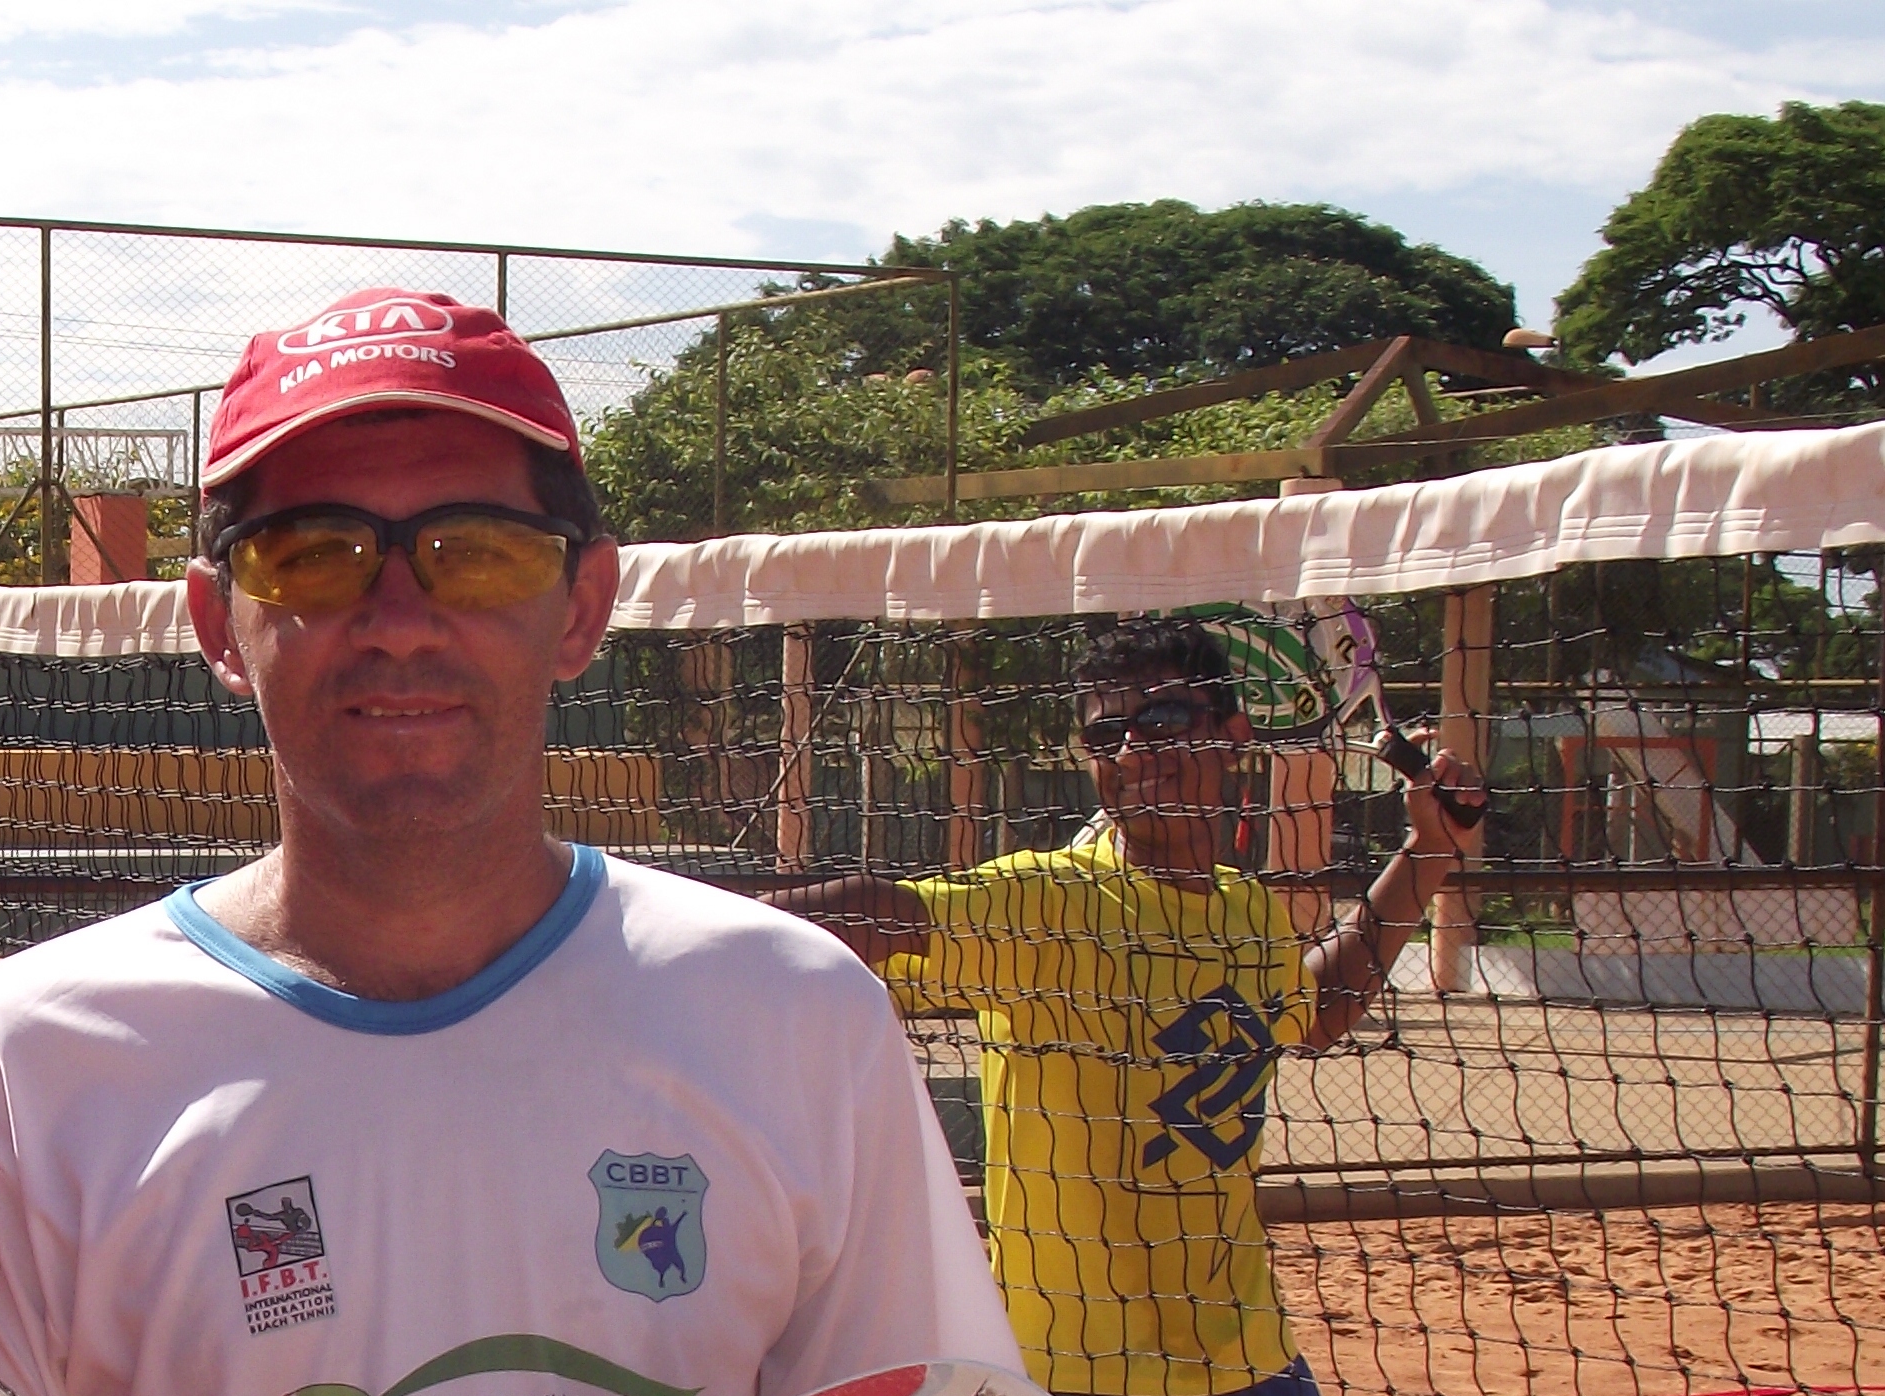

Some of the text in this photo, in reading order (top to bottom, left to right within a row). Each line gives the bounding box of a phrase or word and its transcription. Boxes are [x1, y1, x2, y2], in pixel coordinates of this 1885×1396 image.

[305, 304, 424, 347] KIA
[279, 343, 457, 394] KIA MOTORS
[605, 1162, 689, 1186] CBBT
[240, 1260, 329, 1299] I.F.B.T.
[245, 1282, 333, 1313] INTERNATIONAL
[246, 1293, 335, 1325] FEDERATION
[248, 1304, 336, 1335] BEACH TENNIS
